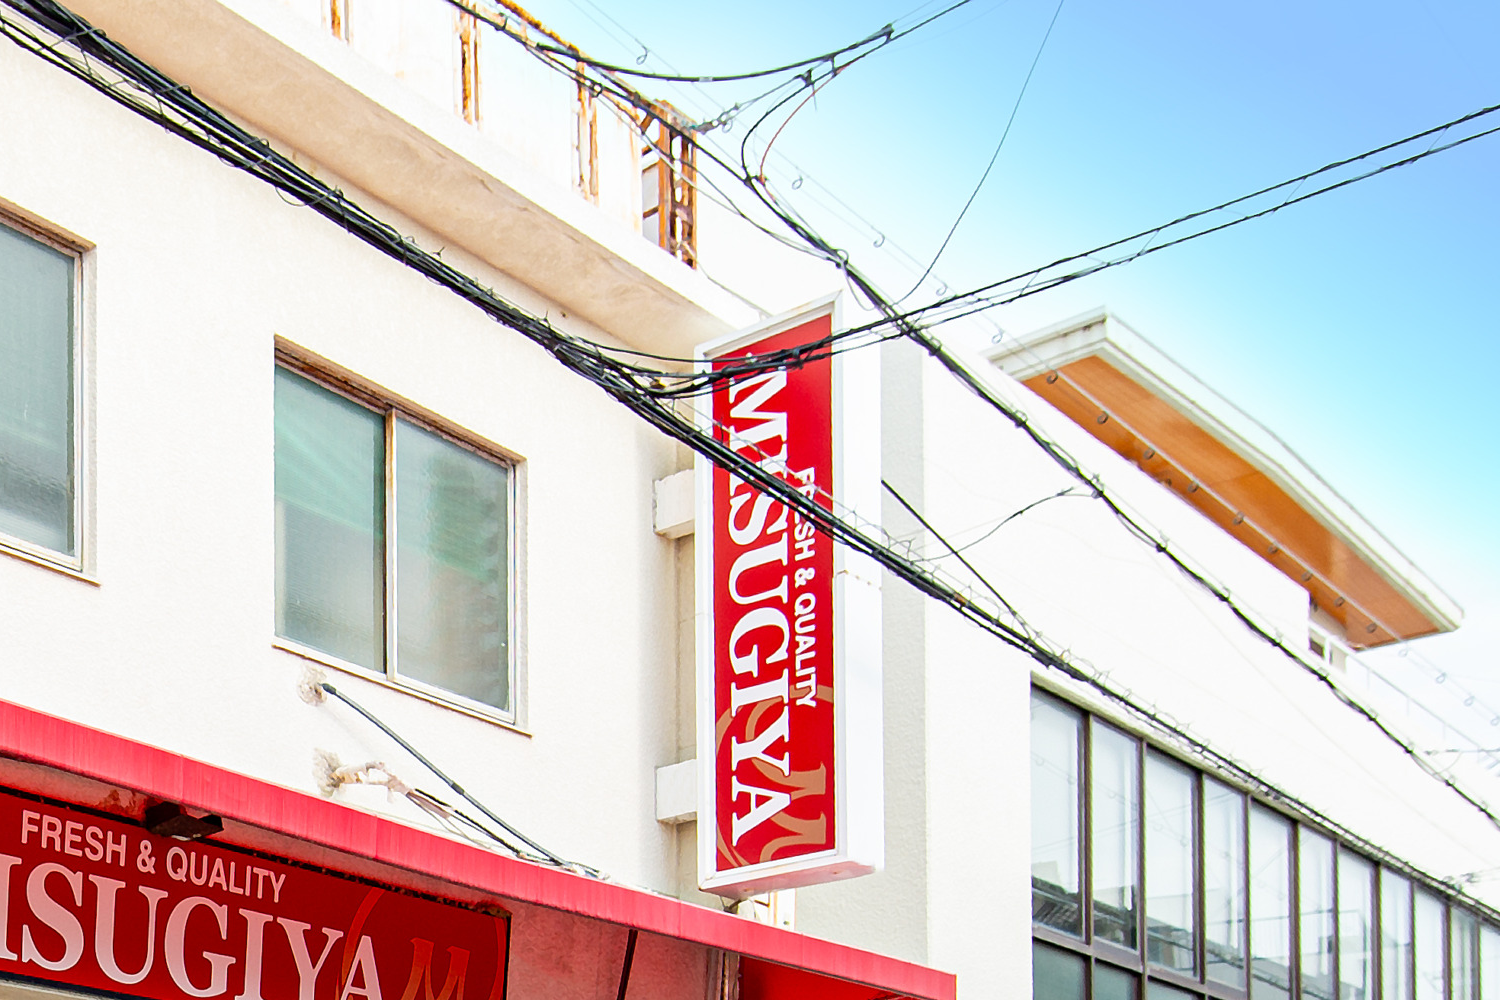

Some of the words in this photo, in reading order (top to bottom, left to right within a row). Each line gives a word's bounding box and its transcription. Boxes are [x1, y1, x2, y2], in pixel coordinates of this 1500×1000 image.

[795, 566, 816, 588] &
[794, 592, 817, 708] QUALITY
[21, 809, 127, 867] FRESH
[138, 840, 156, 874] &
[165, 845, 286, 904] QUALITY
